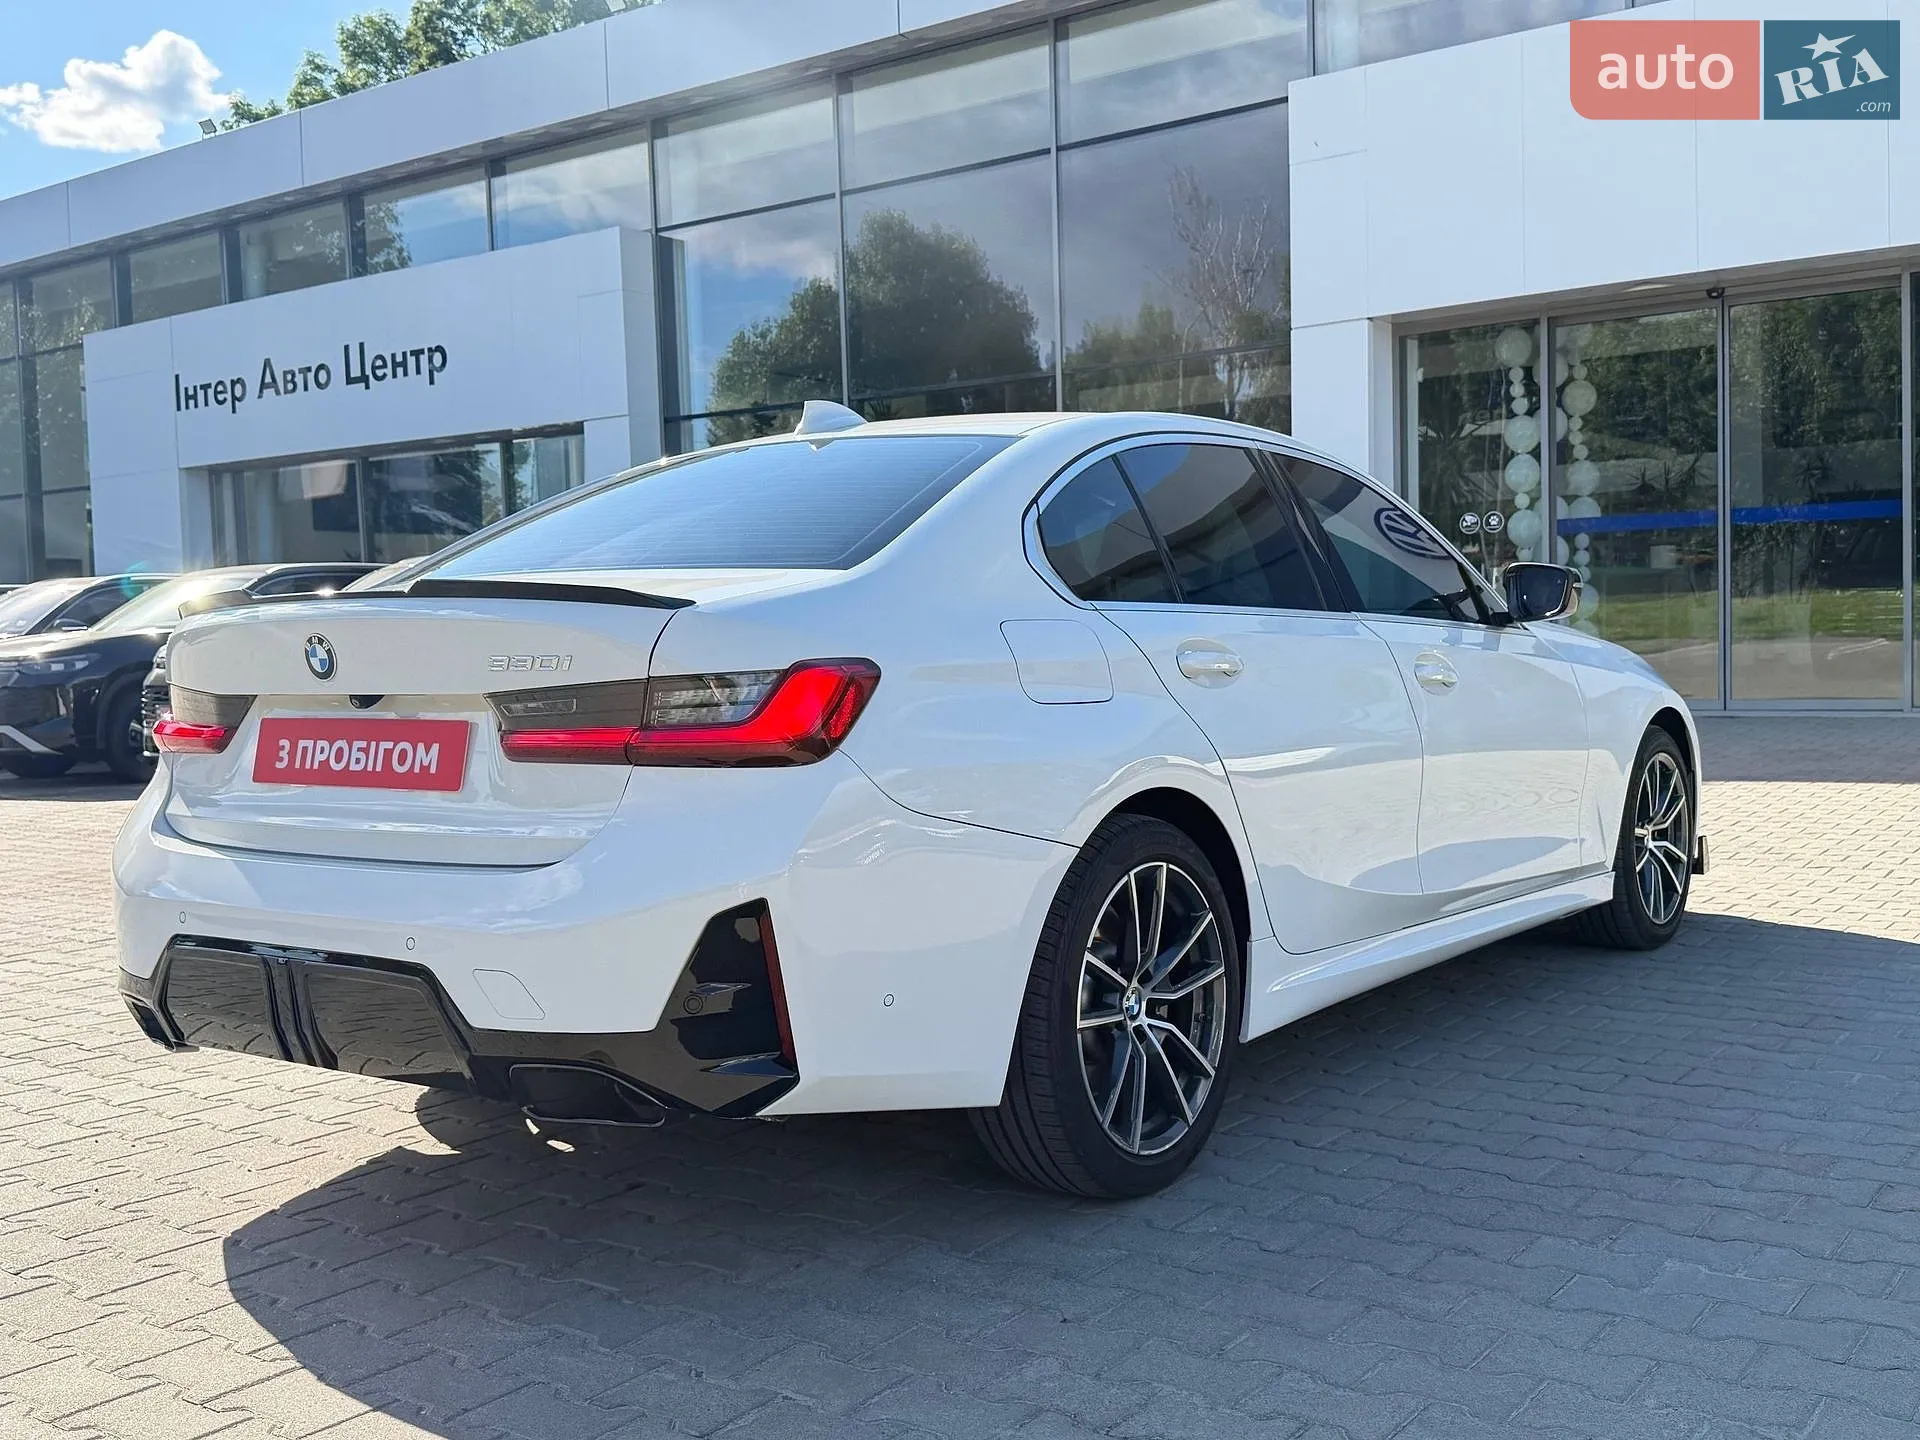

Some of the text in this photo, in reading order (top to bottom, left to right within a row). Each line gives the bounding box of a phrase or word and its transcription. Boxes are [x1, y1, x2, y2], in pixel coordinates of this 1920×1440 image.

[174, 341, 448, 414] Інтер Авто Центр
[487, 654, 573, 672] 330i
[294, 739, 440, 774] ПРОБІГОМ
